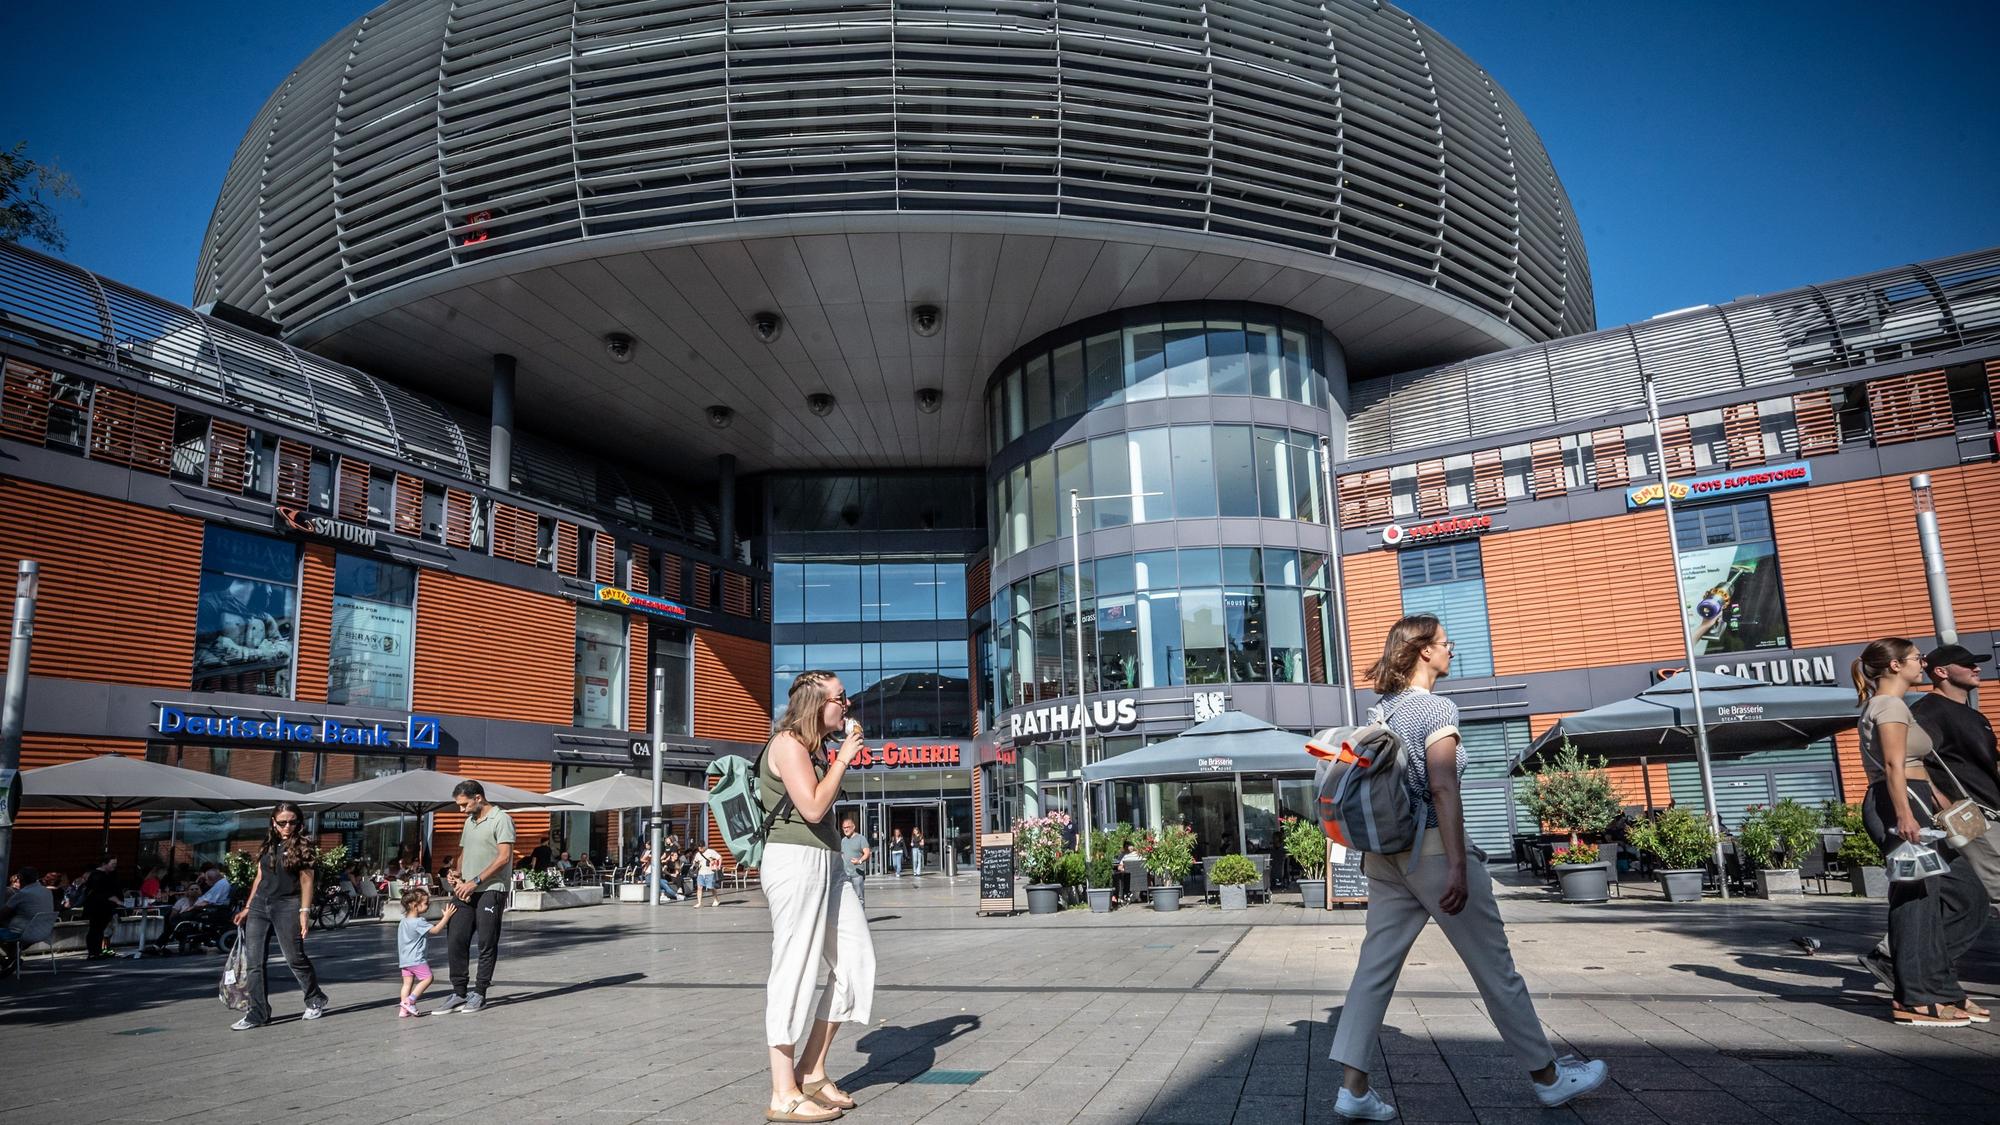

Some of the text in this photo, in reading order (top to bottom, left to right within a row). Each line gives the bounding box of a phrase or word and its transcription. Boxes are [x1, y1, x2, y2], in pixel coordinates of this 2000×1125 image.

[1633, 467, 1806, 502] SMYHS TOYS SUPERSTORES
[314, 517, 376, 546] SATURN
[1408, 515, 1493, 537] vodafone
[600, 588, 632, 605] SMYTHS
[1010, 698, 1137, 737] RATHAUS
[1718, 704, 1764, 716] Die Brasserie
[159, 705, 391, 746] Deutsche Bank
[1209, 758, 1232, 766] Brasserie
